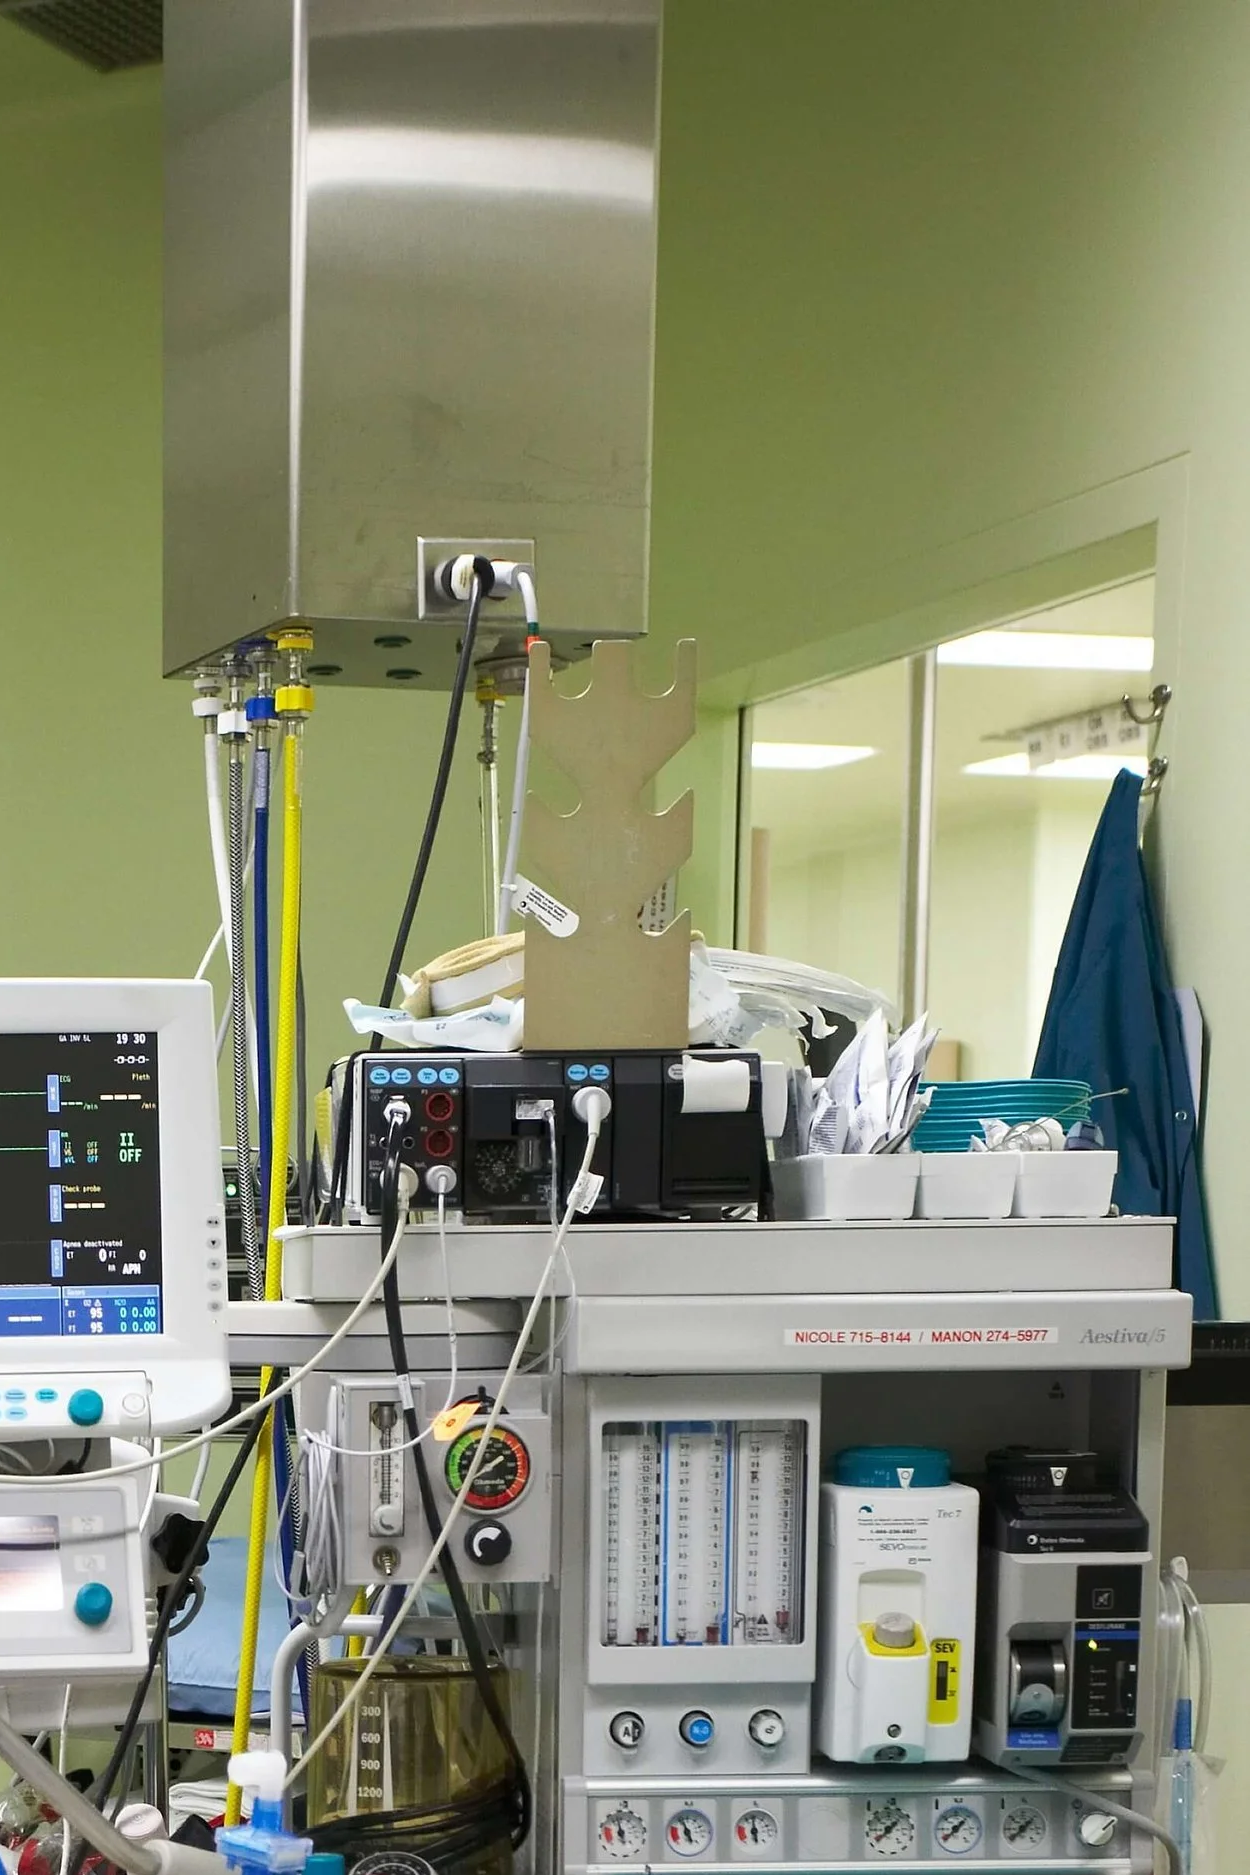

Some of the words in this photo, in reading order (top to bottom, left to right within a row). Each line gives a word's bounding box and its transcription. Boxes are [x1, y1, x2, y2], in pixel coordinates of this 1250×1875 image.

[60, 1075, 71, 1083] ECG
[120, 1133, 134, 1147] II
[119, 1149, 142, 1163] OFF
[139, 1249, 147, 1261] 0
[90, 1307, 103, 1319] 95
[120, 1307, 127, 1318] 0
[132, 1306, 156, 1318] 0.00
[90, 1321, 103, 1333] 95
[120, 1321, 127, 1332] 0
[132, 1321, 157, 1332] 0.00
[795, 1332, 846, 1343] NICOLE
[850, 1331, 911, 1343] 715-8144
[931, 1331, 982, 1343] MANON
[986, 1330, 1048, 1342] 274-5977
[1080, 1328, 1166, 1347] Aestiva/5
[937, 1509, 954, 1518] Tec
[935, 1643, 956, 1653] SEV
[361, 1706, 381, 1717] 300
[361, 1732, 381, 1744] 600
[360, 1759, 381, 1771] 900
[358, 1786, 383, 1798] 1200
